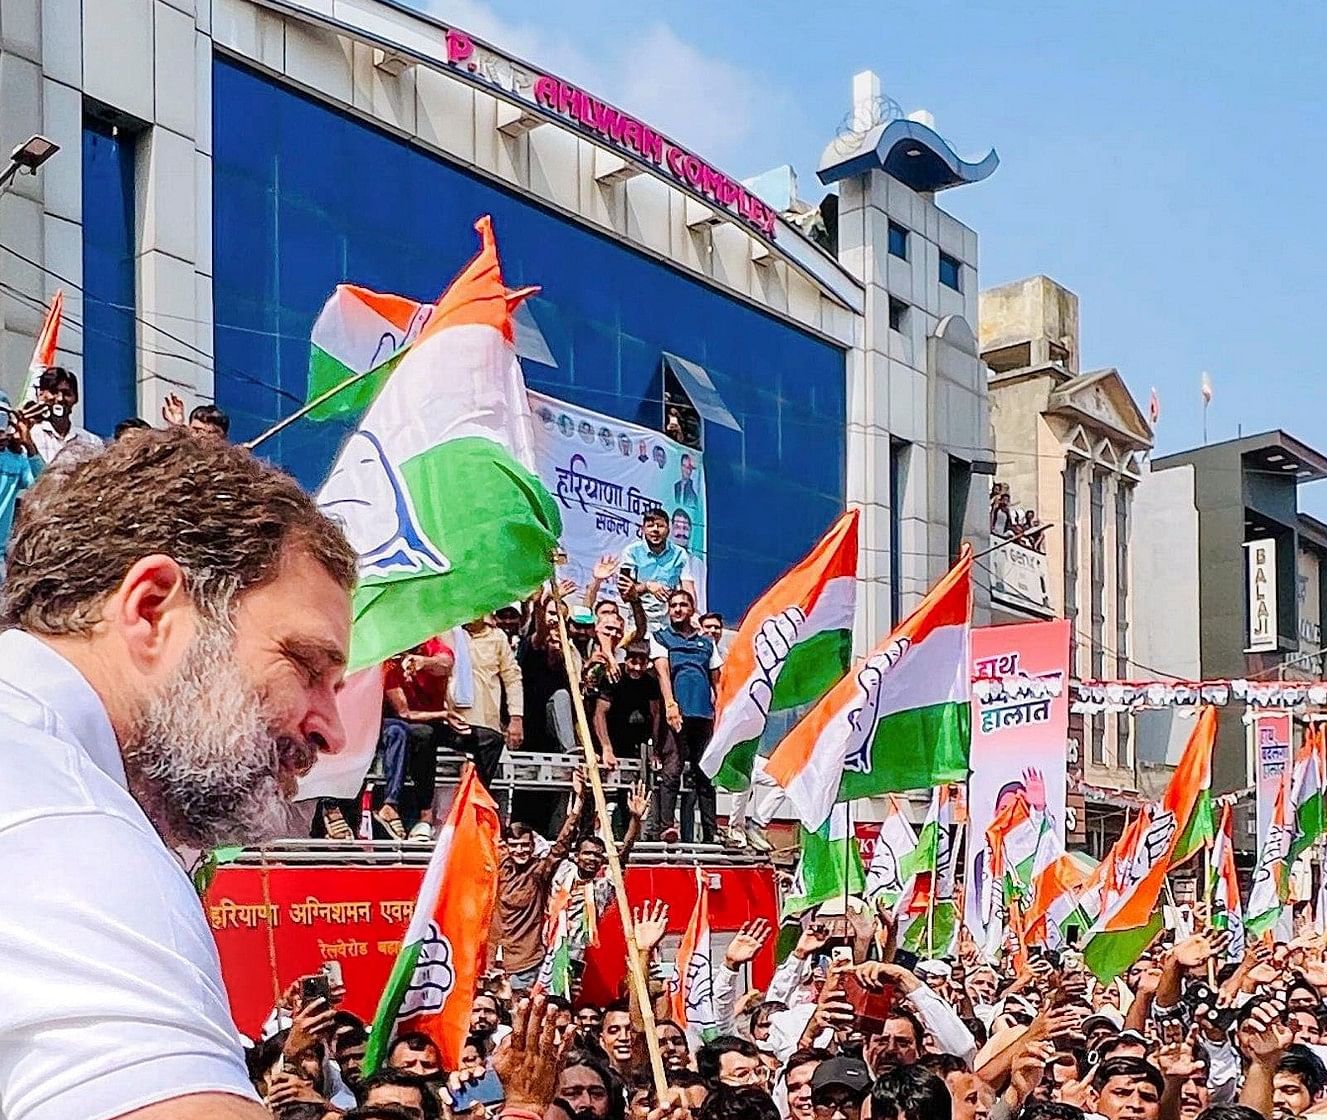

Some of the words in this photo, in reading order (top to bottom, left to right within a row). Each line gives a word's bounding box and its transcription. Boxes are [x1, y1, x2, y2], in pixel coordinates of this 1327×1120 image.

[510, 62, 663, 165] PAHLWAN
[667, 145, 778, 239] COMPLEX
[554, 453, 624, 513] हरियाणा
[1254, 548, 1269, 635] BALAJI
[981, 699, 1051, 733] हालात
[208, 896, 279, 929] हरियाणा
[289, 896, 372, 925] अग्निशमन
